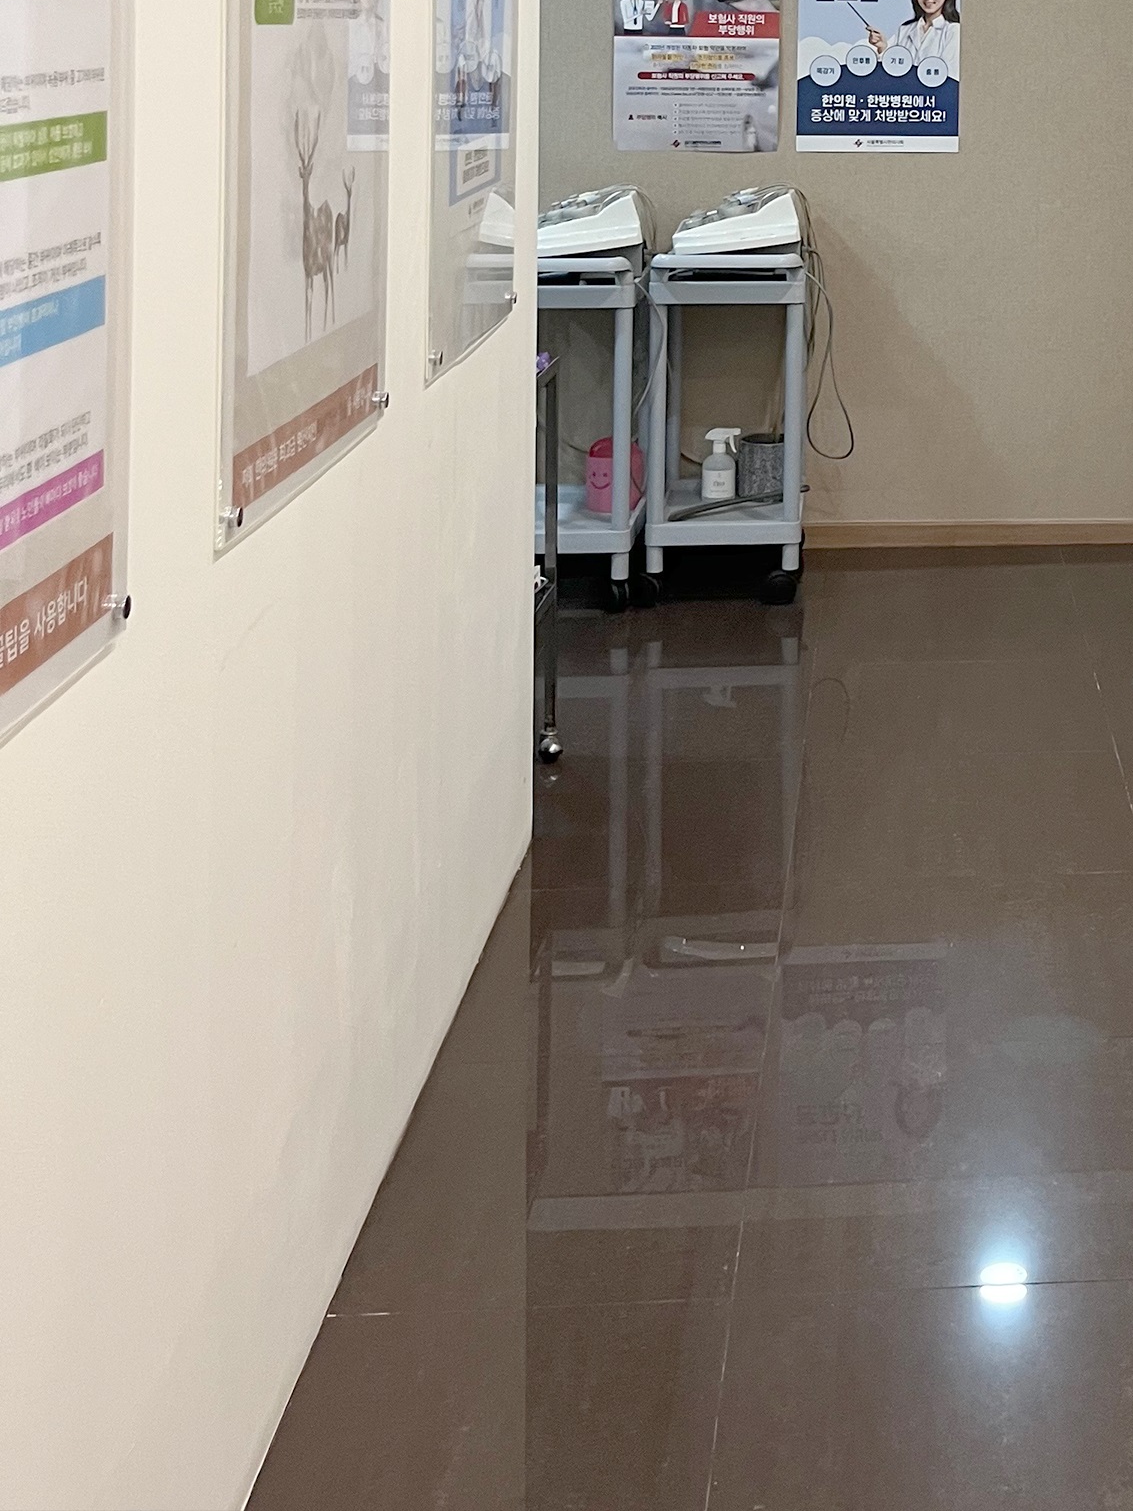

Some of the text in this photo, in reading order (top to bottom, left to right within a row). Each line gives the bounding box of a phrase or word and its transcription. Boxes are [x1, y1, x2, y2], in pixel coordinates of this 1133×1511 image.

[707, 13, 765, 24] 보험사 직원의
[718, 24, 755, 36] 부당행위
[821, 94, 936, 108] 한의원 한방병원에서
[810, 109, 946, 123] 증상에 맞게 처방받으세요!
[34, 575, 88, 641] 사용합니다
